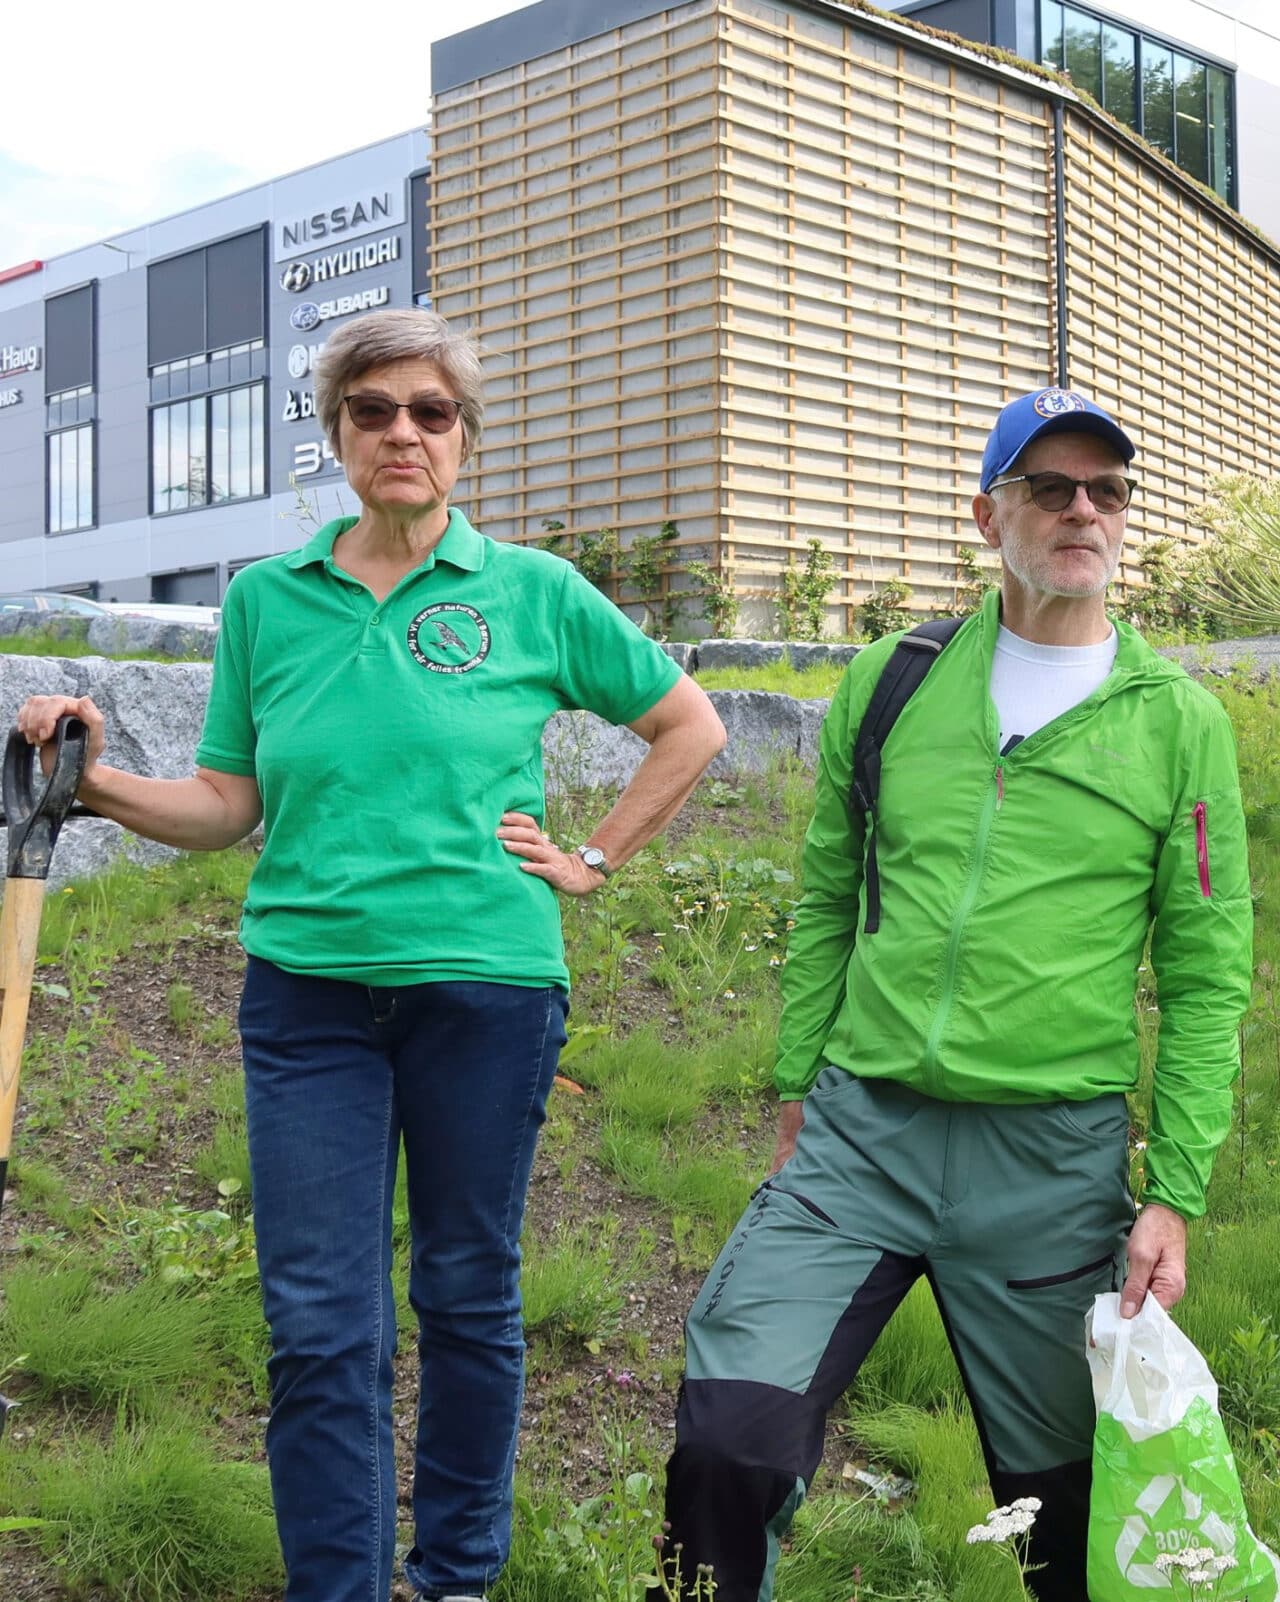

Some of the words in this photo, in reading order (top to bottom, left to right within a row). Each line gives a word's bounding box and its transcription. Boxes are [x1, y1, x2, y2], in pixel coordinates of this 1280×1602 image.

[283, 192, 388, 248] NISSAN
[314, 236, 399, 282] HYUNDAI
[319, 286, 388, 320] SUBARU
[3, 346, 37, 371] Haug
[415, 606, 441, 622] verner
[444, 604, 478, 618] naturen
